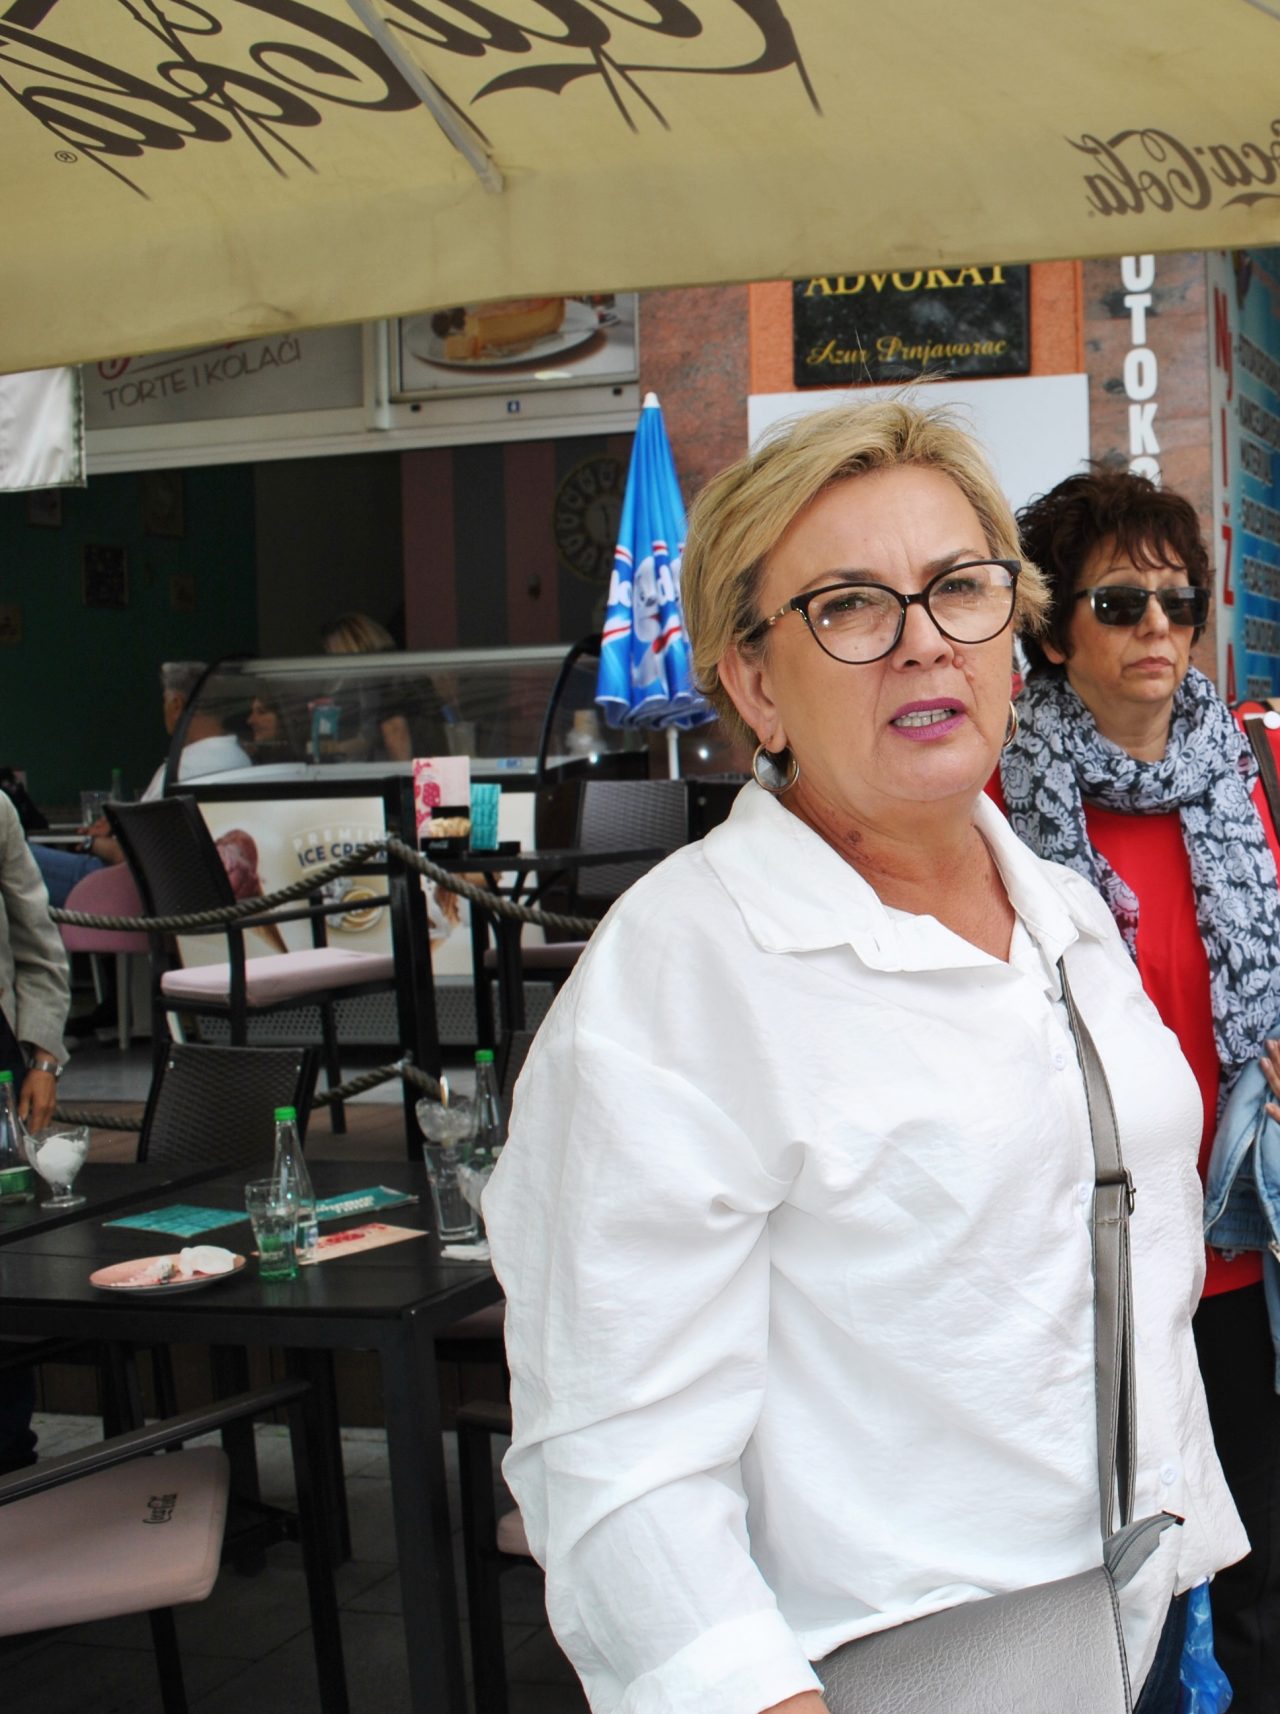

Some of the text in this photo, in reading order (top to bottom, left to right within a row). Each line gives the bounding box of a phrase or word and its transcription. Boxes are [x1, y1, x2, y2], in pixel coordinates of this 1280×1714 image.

[804, 264, 1007, 297] ADVOKAT
[102, 334, 302, 410] TORTE I KOLAČI
[297, 845, 326, 867] ICE
